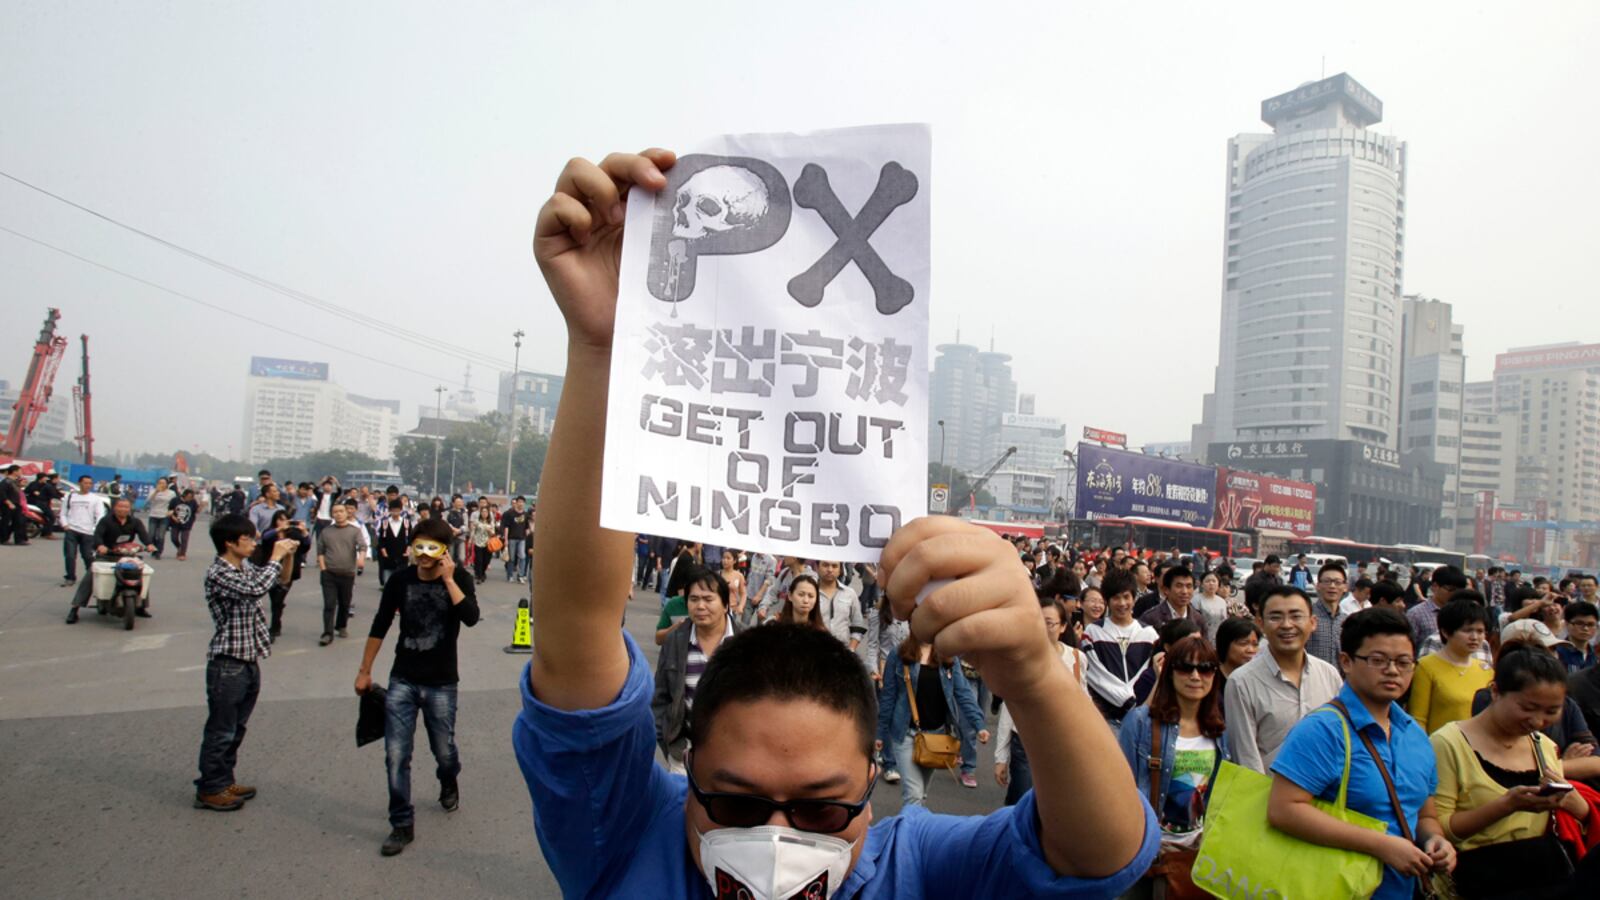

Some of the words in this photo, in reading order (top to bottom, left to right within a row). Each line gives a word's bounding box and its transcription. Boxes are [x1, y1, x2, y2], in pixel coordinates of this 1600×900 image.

[640, 322, 913, 406] 滚出宁波
[639, 394, 764, 449] GET
[784, 411, 906, 458] OUT
[727, 451, 819, 498] OF
[637, 475, 902, 549] NINGBO
